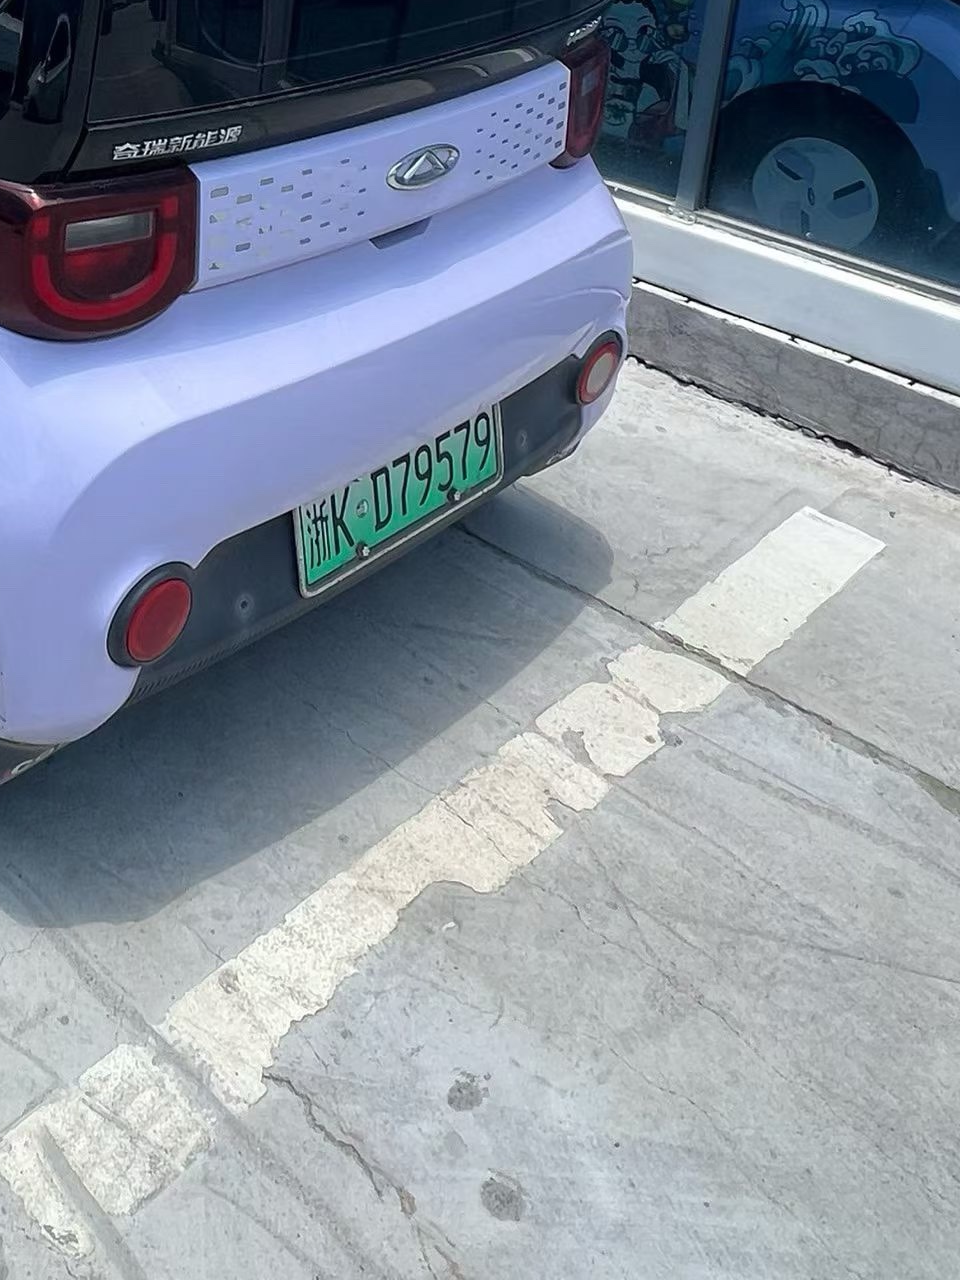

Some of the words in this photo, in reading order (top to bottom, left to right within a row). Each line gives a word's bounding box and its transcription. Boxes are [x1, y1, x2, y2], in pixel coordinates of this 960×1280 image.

[112, 125, 242, 160] 奇瑞新能源
